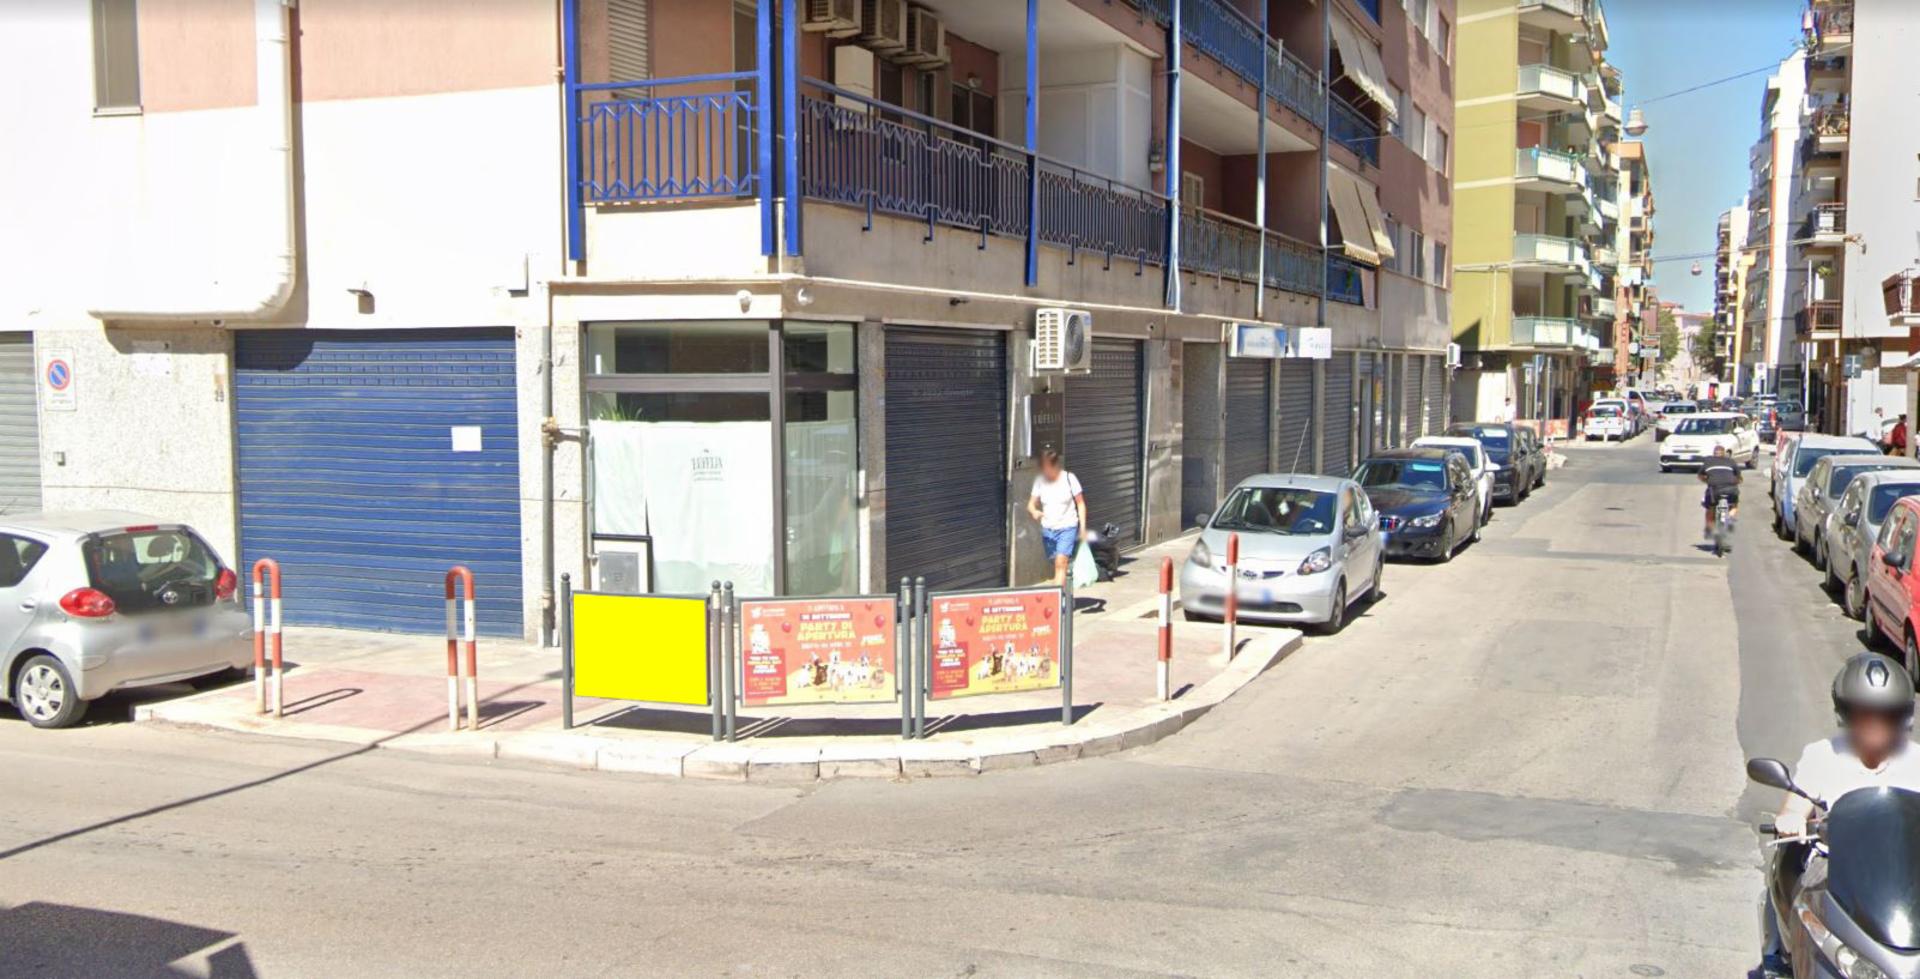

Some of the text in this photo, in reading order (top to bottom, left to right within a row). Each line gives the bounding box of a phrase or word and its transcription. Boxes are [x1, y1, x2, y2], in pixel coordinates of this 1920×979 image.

[981, 615, 1012, 624] PARTY
[800, 621, 853, 631] PARTY DI
[979, 622, 1028, 633] APERTURA
[797, 630, 856, 641] APERTURA
